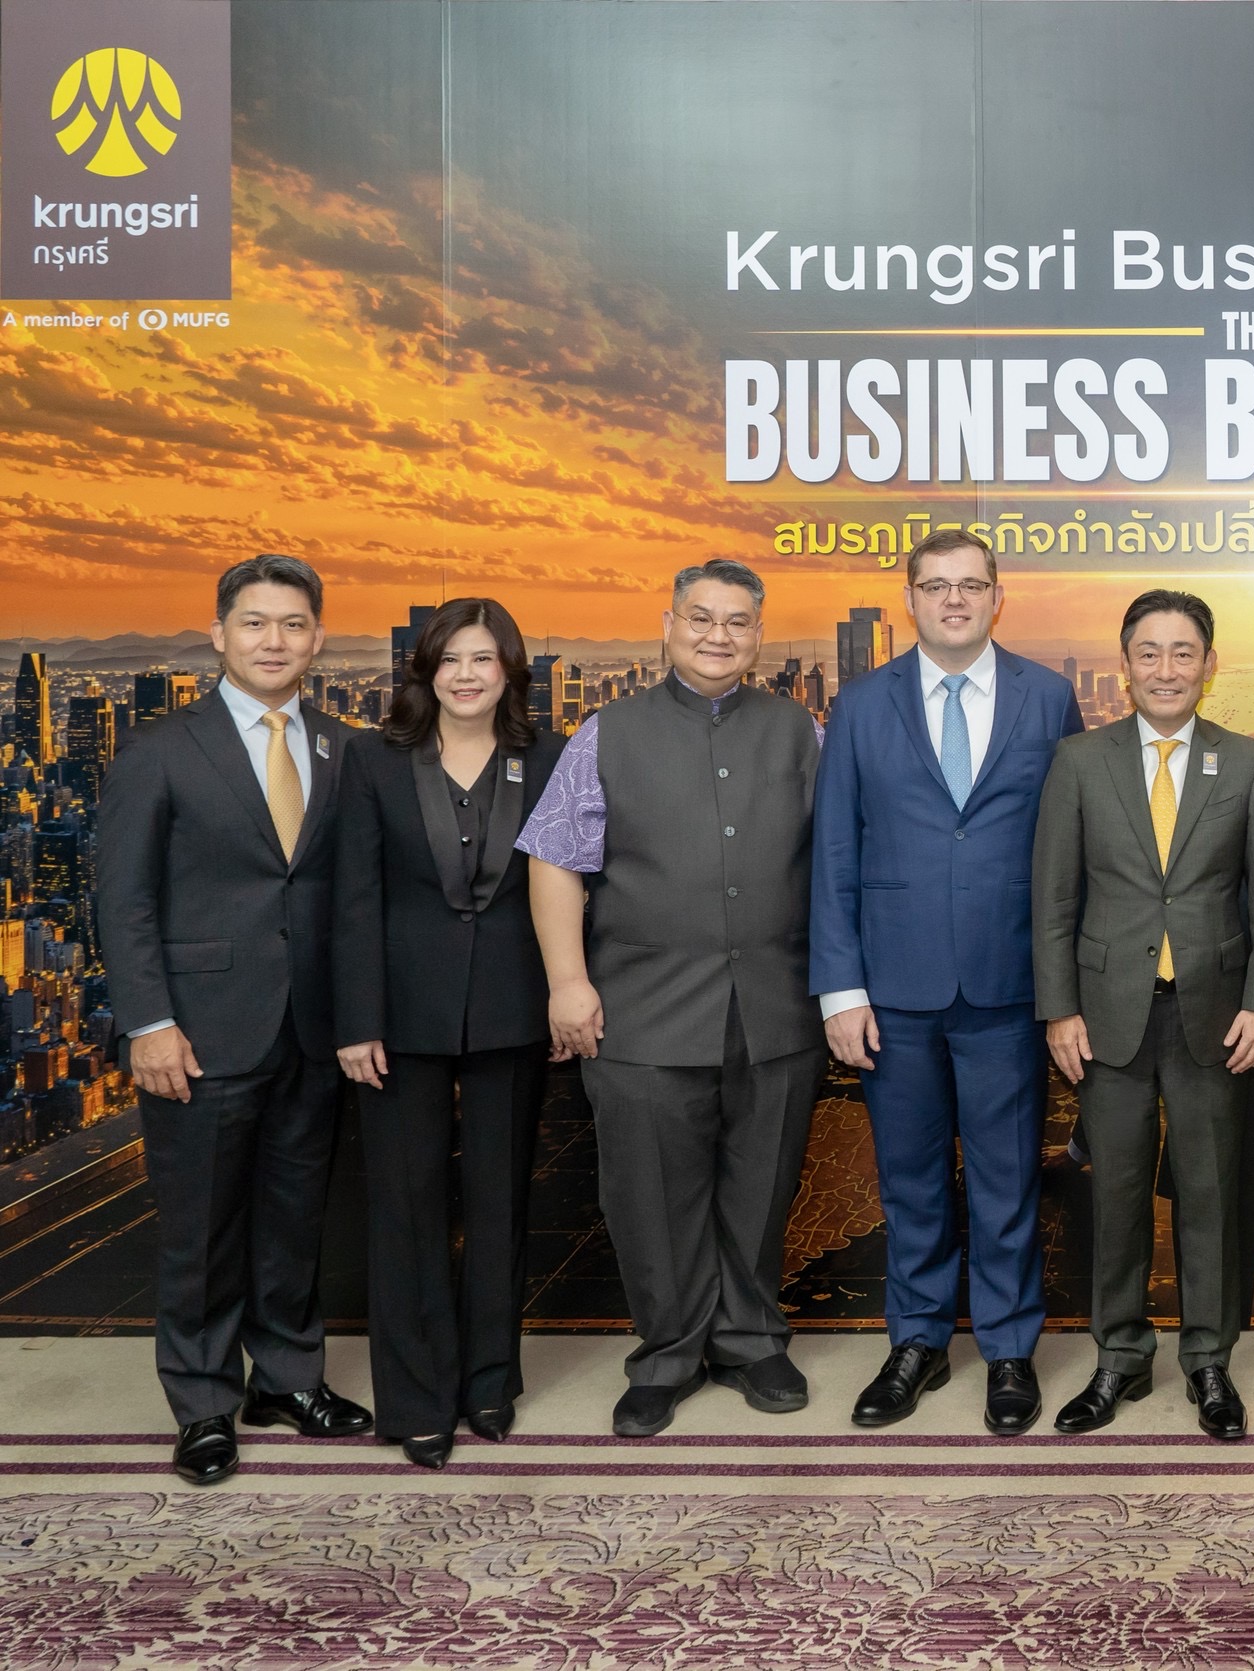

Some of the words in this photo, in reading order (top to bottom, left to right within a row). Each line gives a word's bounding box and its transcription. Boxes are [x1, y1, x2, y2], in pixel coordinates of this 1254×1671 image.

[34, 194, 198, 236] krungsri
[34, 237, 109, 272] กรุงศรี
[726, 228, 1076, 305] Krungsri
[3, 312, 17, 327] A
[24, 312, 103, 327] member
[109, 312, 129, 330] of
[173, 312, 230, 328] MUFG
[725, 357, 1170, 483] BUSINESS
